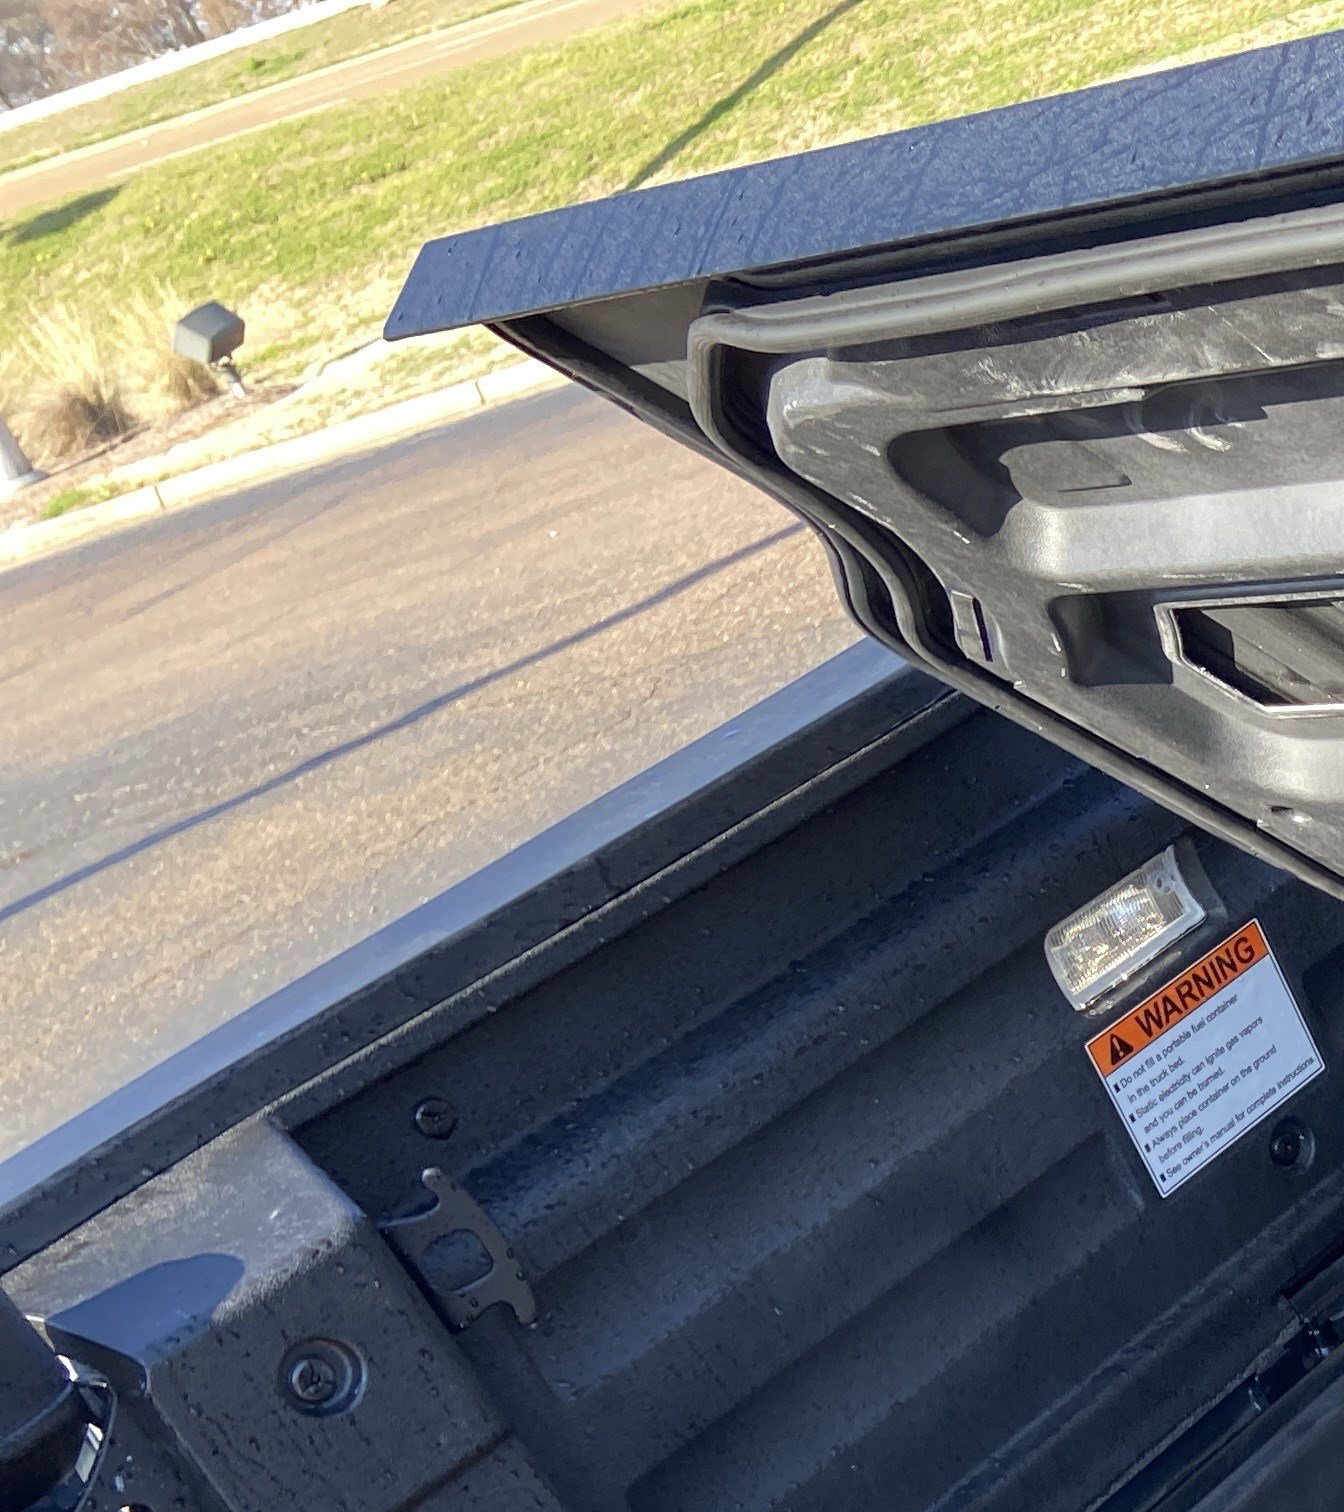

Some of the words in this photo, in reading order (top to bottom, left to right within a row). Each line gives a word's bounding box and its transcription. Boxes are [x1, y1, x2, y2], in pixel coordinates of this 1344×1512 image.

[1134, 936, 1254, 1037] WARNING
[1119, 1075, 1133, 1089] Do
[1132, 1063, 1146, 1079] not
[1144, 1056, 1155, 1068] fill
[1155, 1053, 1162, 1062] a
[1161, 1030, 1191, 1058] portable
[1190, 1016, 1206, 1034] fuel
[1205, 993, 1237, 1022] container
[1134, 1098, 1158, 1118] Static
[1158, 1072, 1191, 1101] electricity
[1190, 1060, 1205, 1075] can
[1204, 1045, 1225, 1065] ignite
[1225, 1034, 1239, 1051] gas
[1238, 1015, 1263, 1038] vapors
[1135, 1083, 1150, 1097] the
[1148, 1068, 1169, 1087] truck
[1167, 1055, 1185, 1073] bed.
[1143, 1116, 1159, 1134] and
[1157, 1107, 1174, 1124] you
[1173, 1095, 1187, 1110] can
[1185, 1087, 1198, 1099] be
[1196, 1066, 1225, 1091] burned.
[1151, 1124, 1178, 1148] Always
[1177, 1108, 1197, 1130] place
[1197, 1081, 1229, 1111] container
[1229, 1074, 1240, 1086] on
[1239, 1064, 1253, 1078] the
[1252, 1043, 1277, 1070] ground
[1165, 1163, 1182, 1178] See
[1209, 1117, 1235, 1143] manual
[1234, 1110, 1245, 1122] for
[1245, 1086, 1277, 1114] complete
[1157, 1141, 1182, 1163] before
